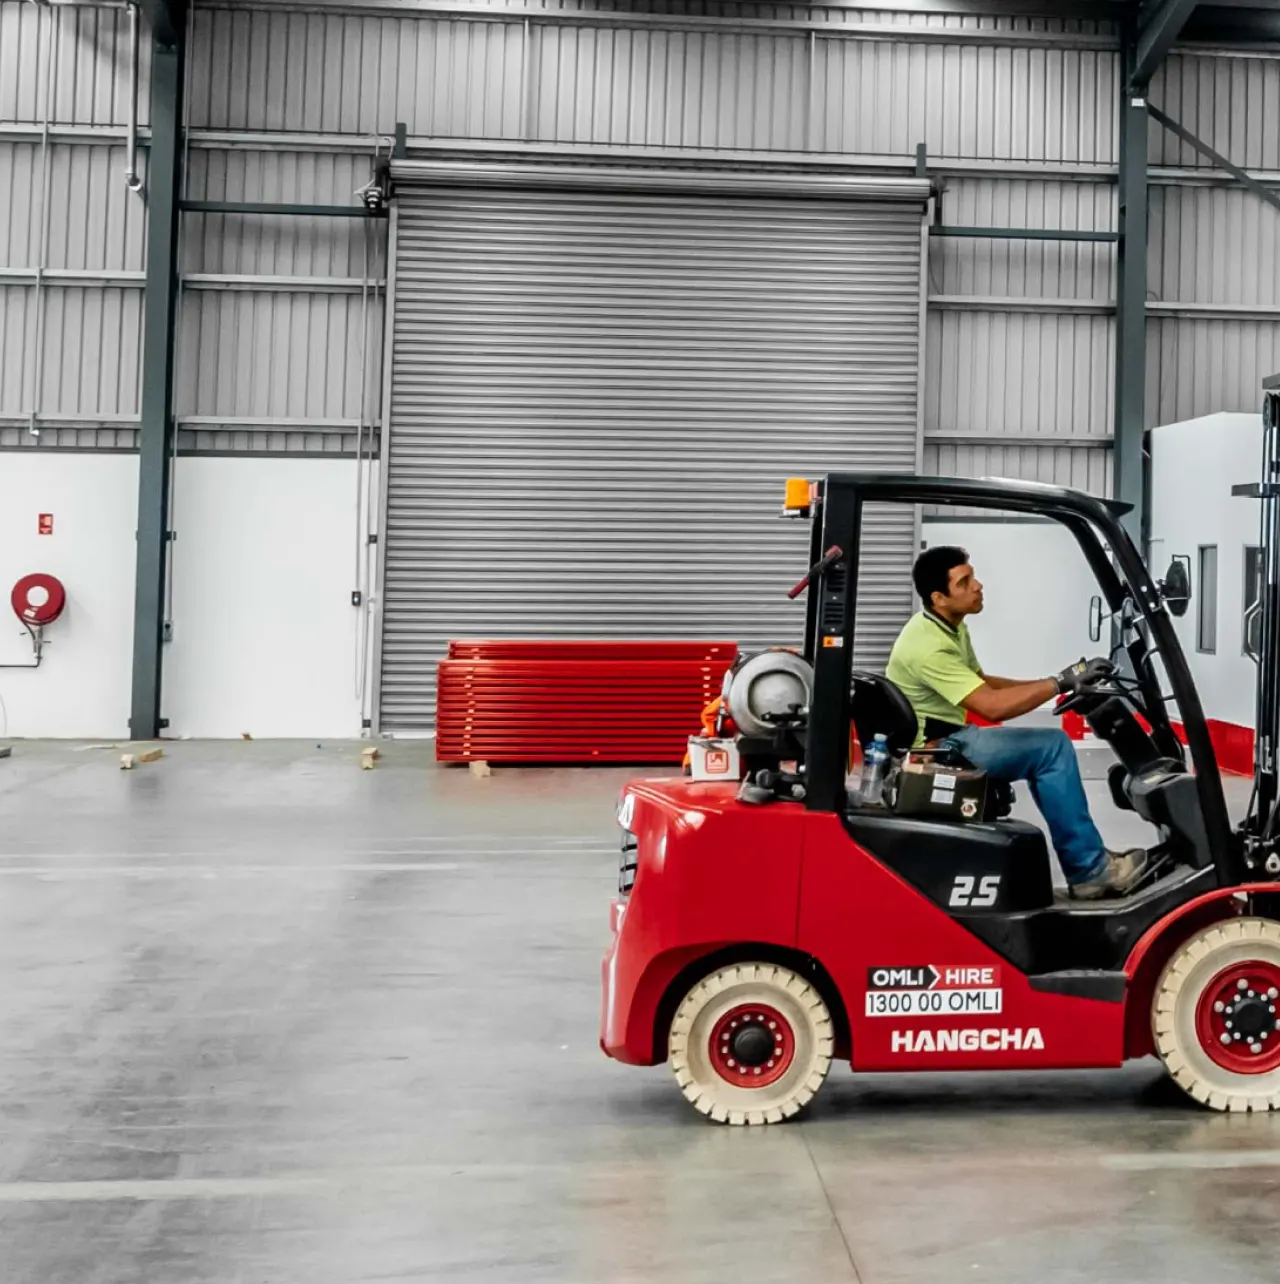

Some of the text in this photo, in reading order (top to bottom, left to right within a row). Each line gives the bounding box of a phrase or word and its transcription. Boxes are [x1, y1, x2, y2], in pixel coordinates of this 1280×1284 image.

[949, 875, 1001, 907] 25
[872, 967, 994, 986] OMLI HIRE
[868, 991, 999, 1013] 1300 00 OMLI
[891, 1027, 1045, 1053] HANGCHA
